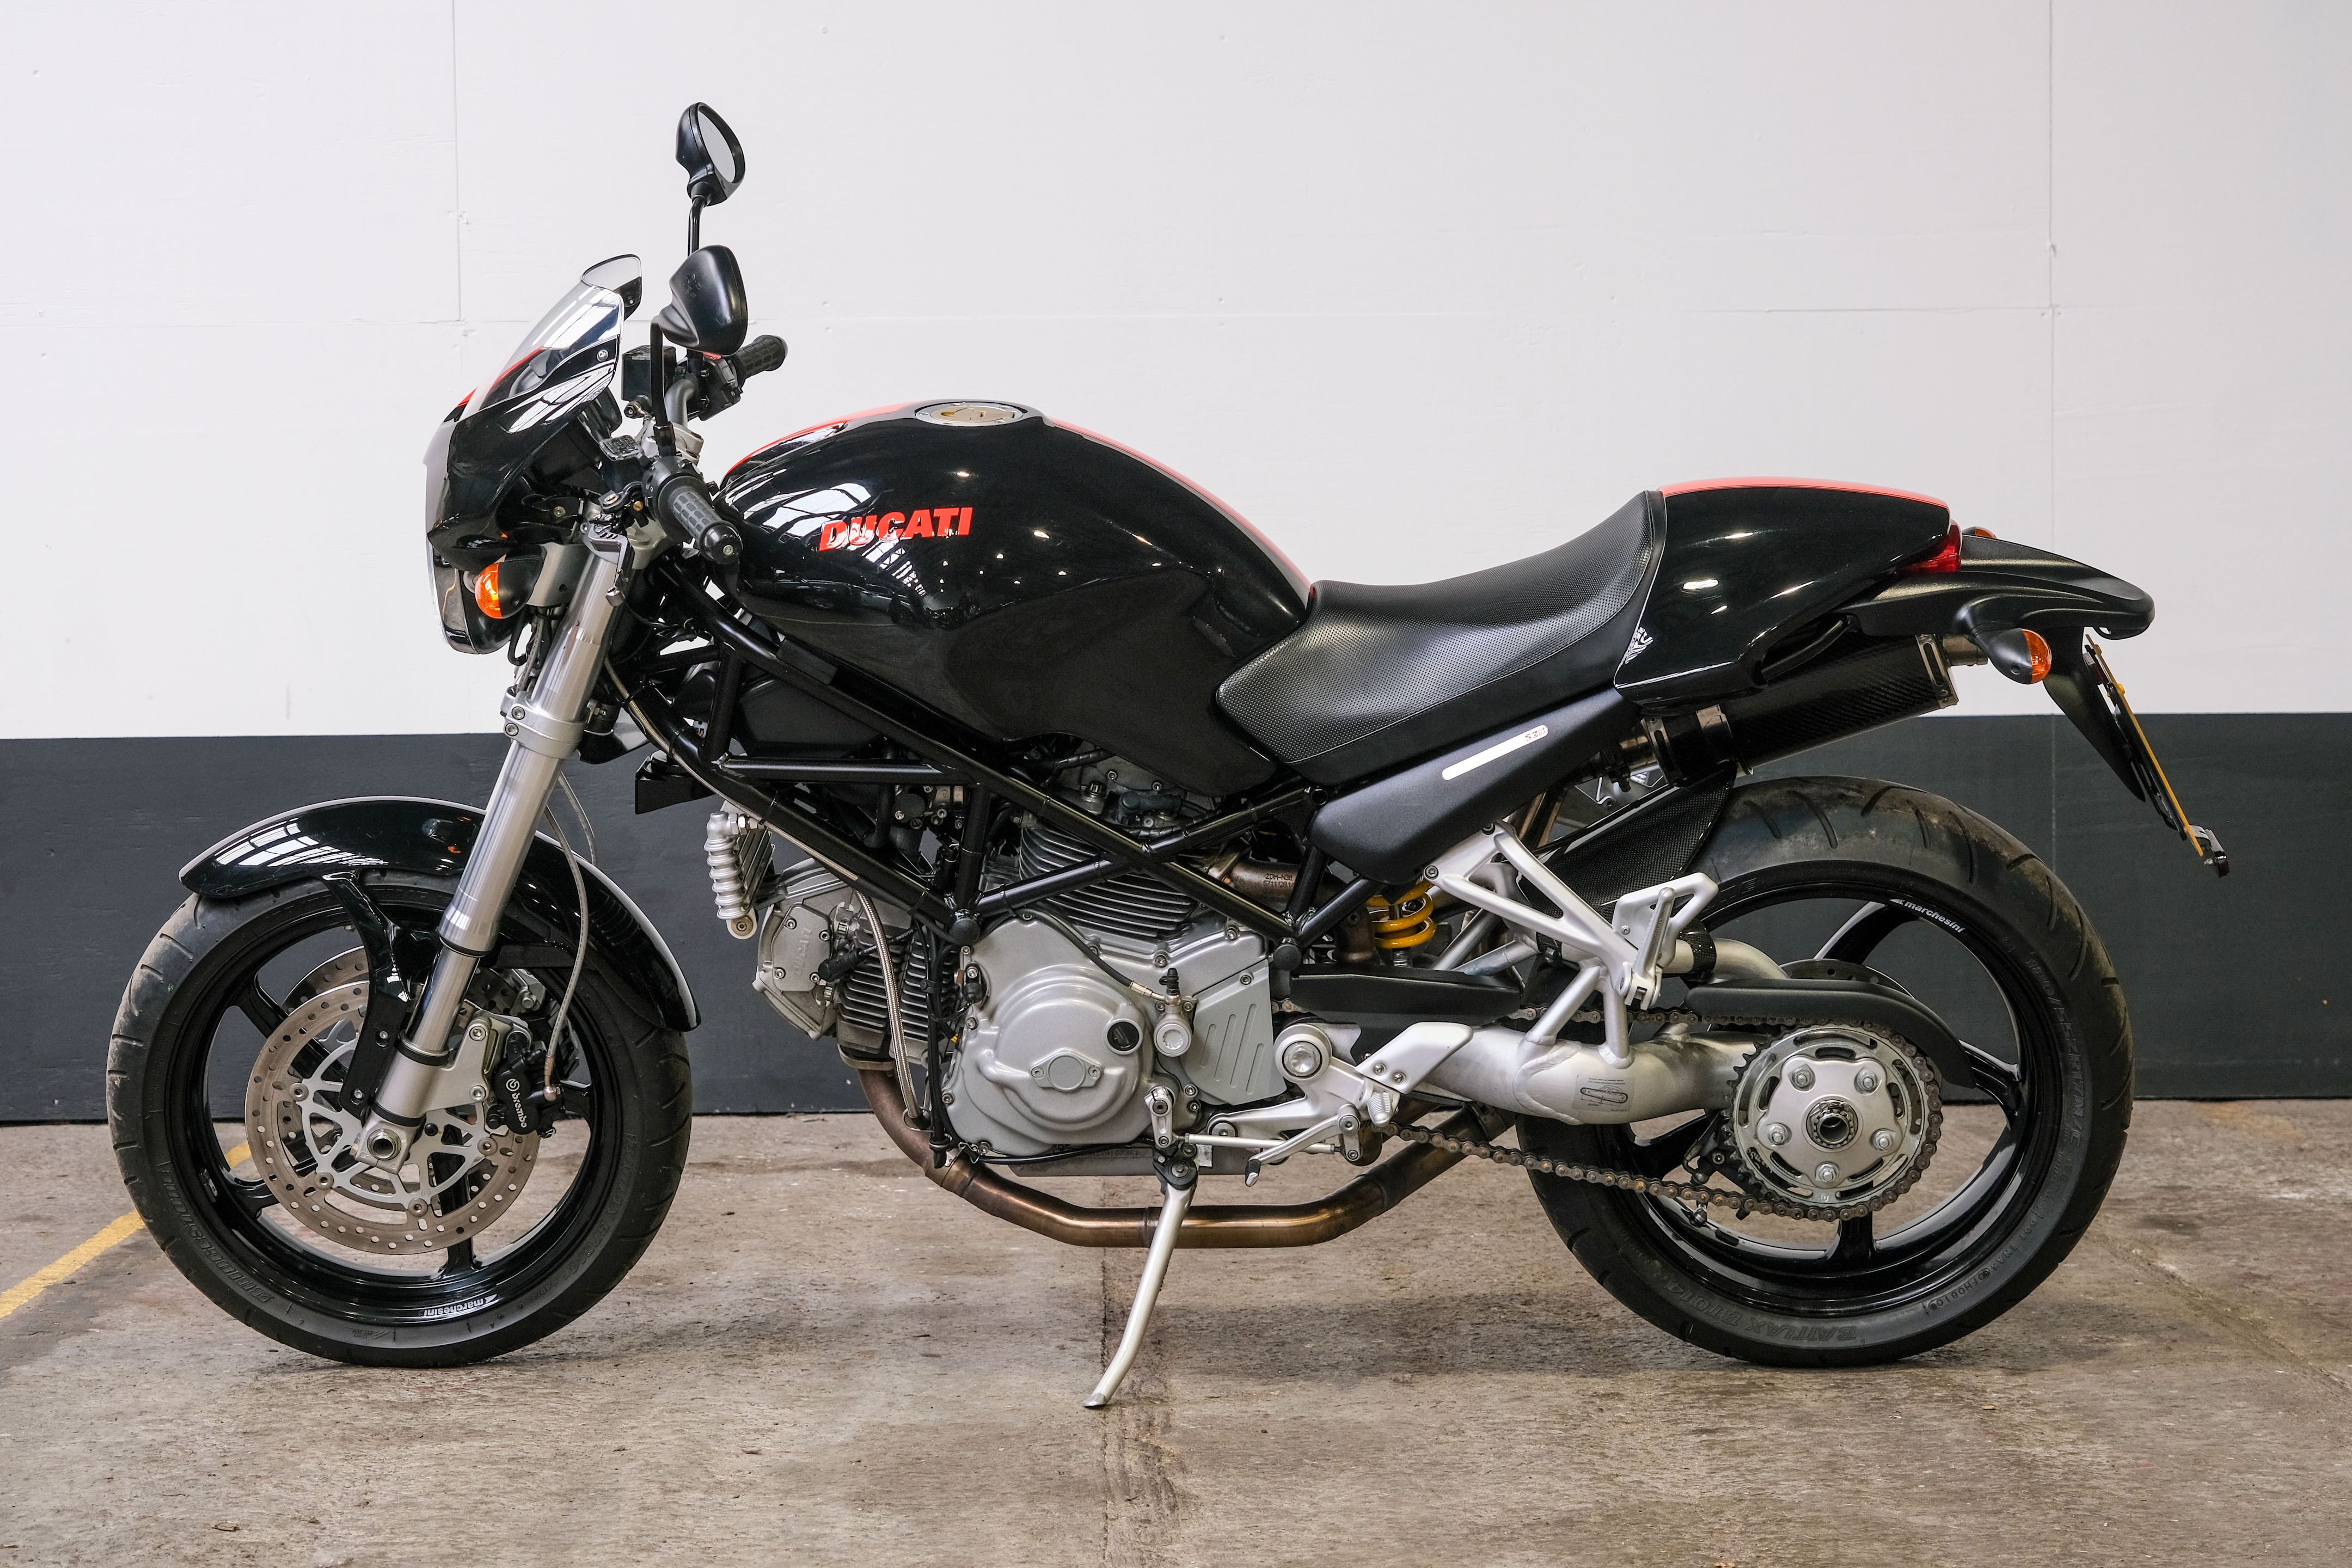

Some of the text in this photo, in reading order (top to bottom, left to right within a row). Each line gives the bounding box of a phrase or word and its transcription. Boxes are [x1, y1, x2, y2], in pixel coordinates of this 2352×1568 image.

[818, 507, 973, 552] DUCATI
[1904, 901, 1966, 933] marchesini
[896, 929, 914, 940] SILICONE
[511, 1092, 528, 1128] brembo
[423, 1298, 485, 1316] marchesini
[1745, 1315, 1858, 1342] BATTLAX
